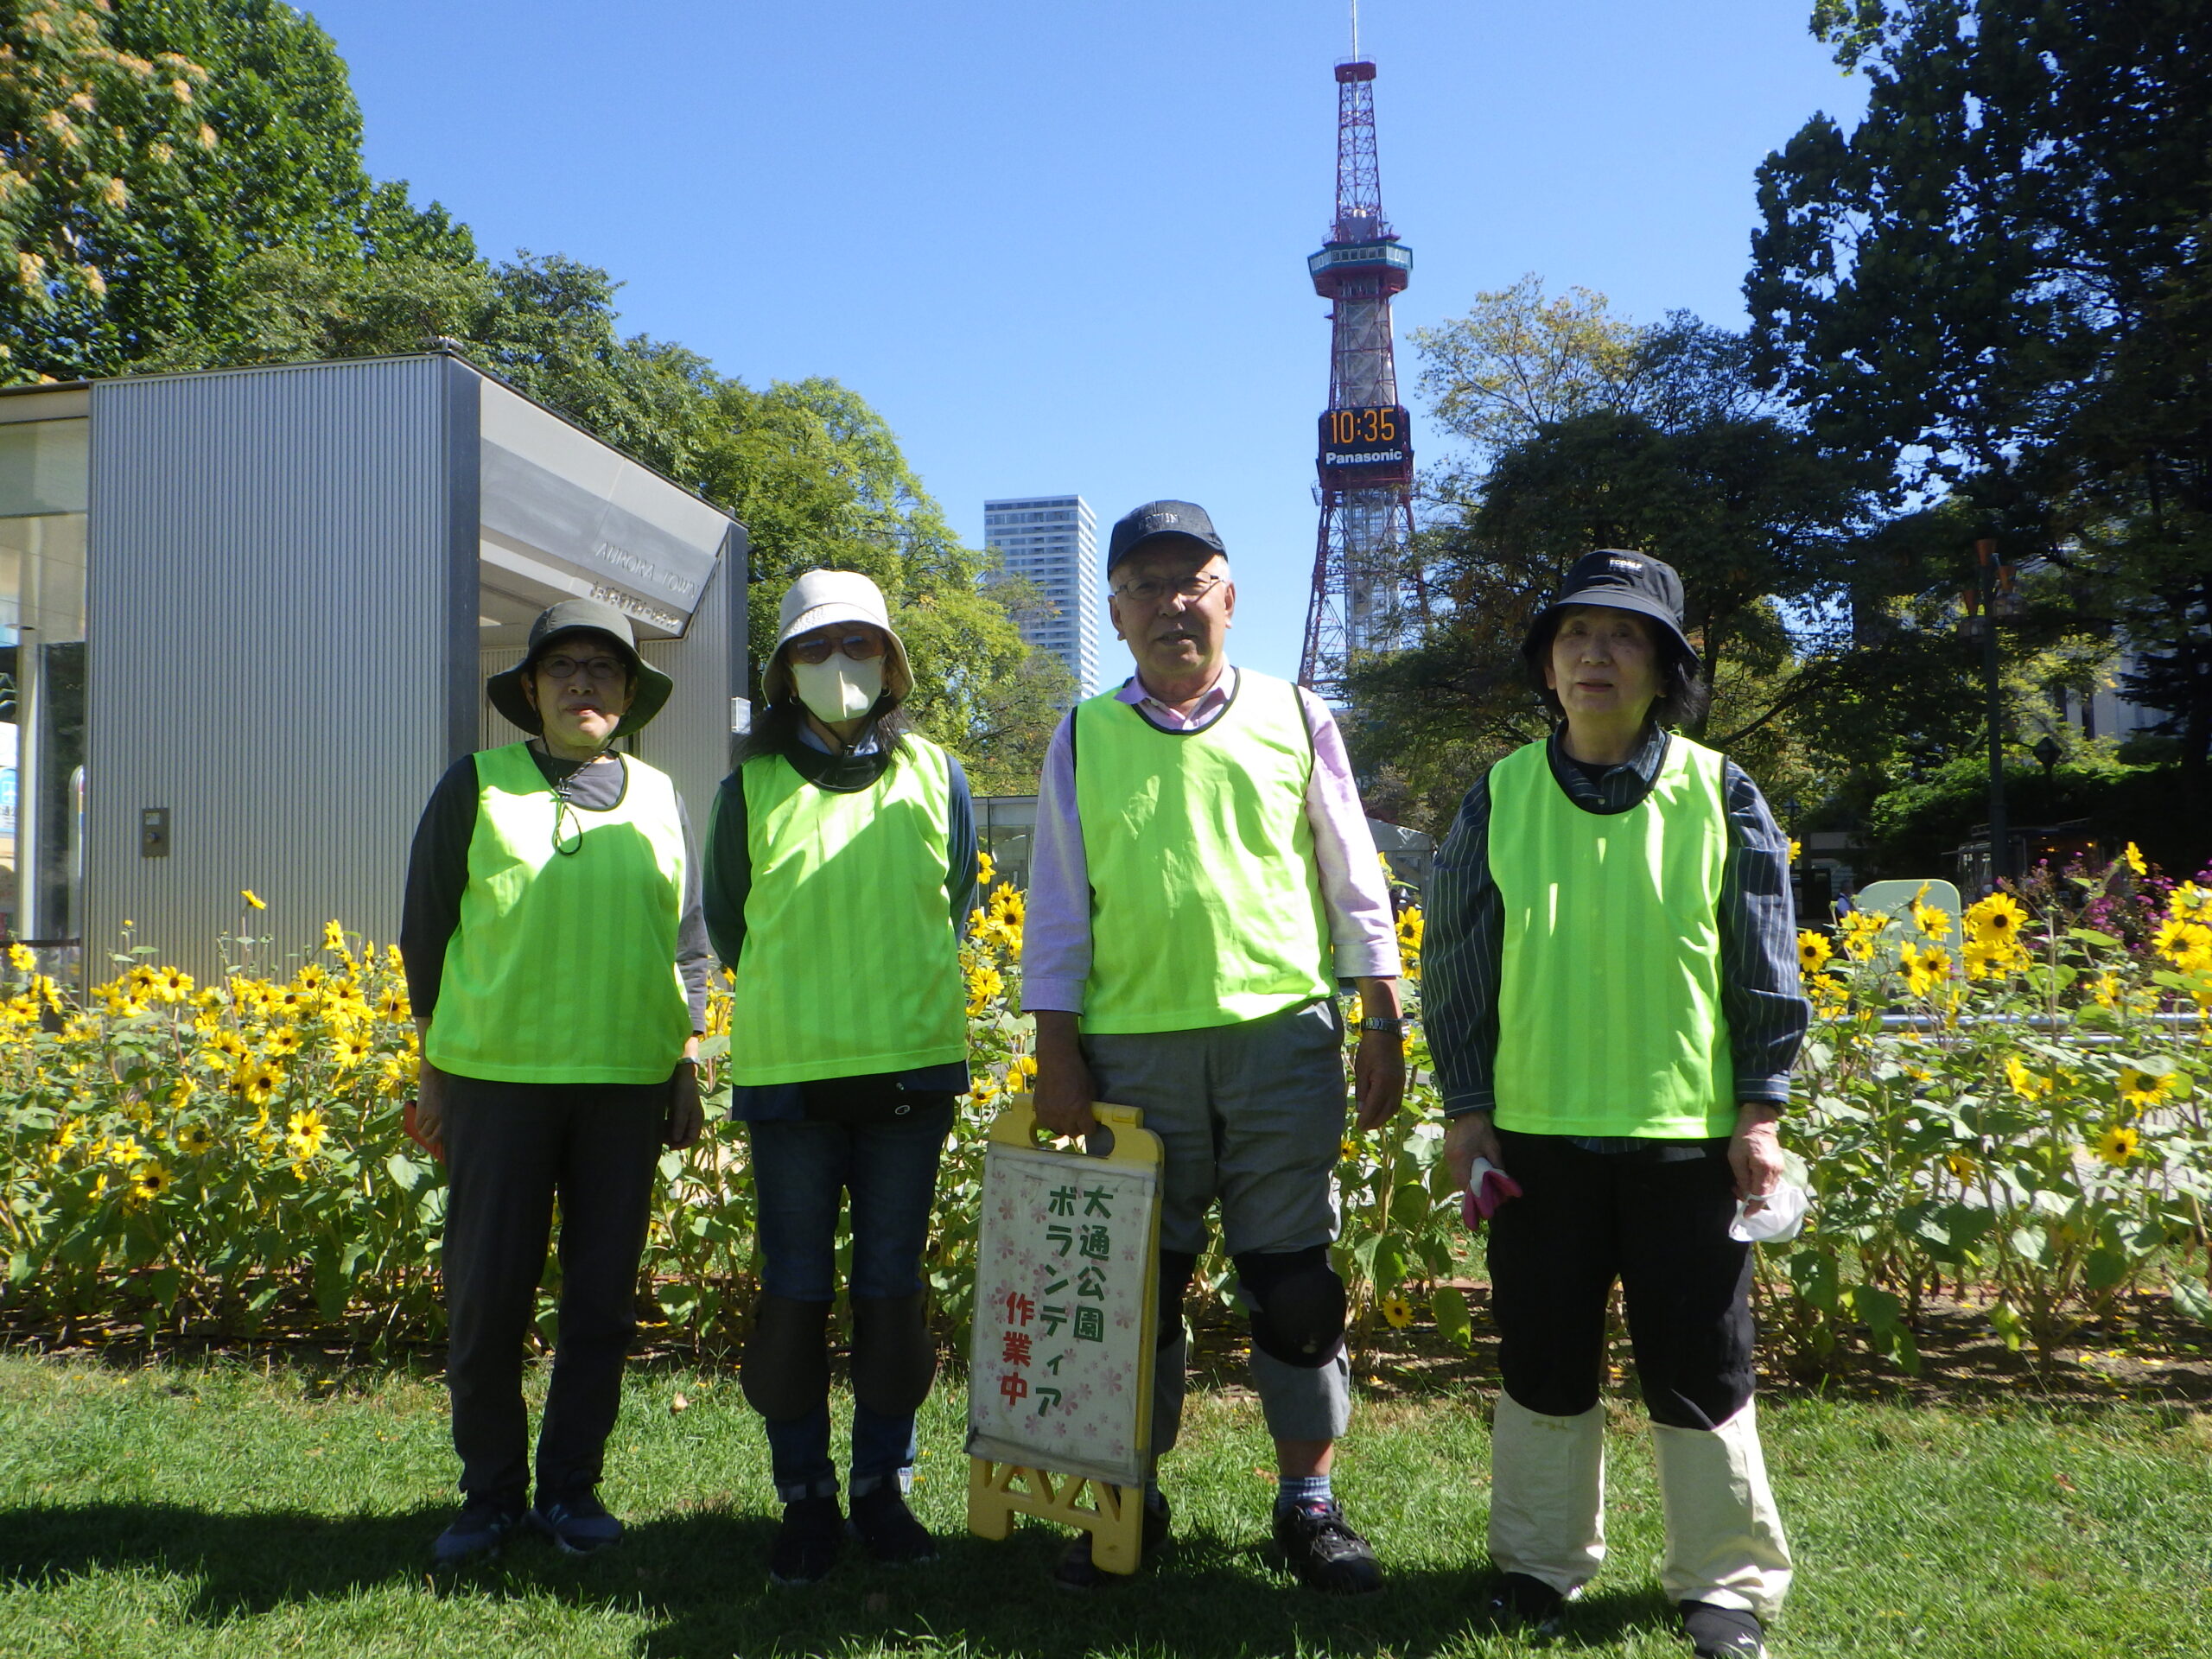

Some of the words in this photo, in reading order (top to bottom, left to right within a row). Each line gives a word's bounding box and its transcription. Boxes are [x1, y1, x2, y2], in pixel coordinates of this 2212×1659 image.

[1325, 448, 1402, 464] Panasonic
[1331, 409, 1395, 444] 10:35
[595, 542, 655, 581] AURORA
[663, 571, 699, 600] TOWN
[1035, 1185, 1077, 1417] ボランティア
[1072, 1185, 1114, 1343] 大通公園
[1000, 1291, 1035, 1406] 作業中
